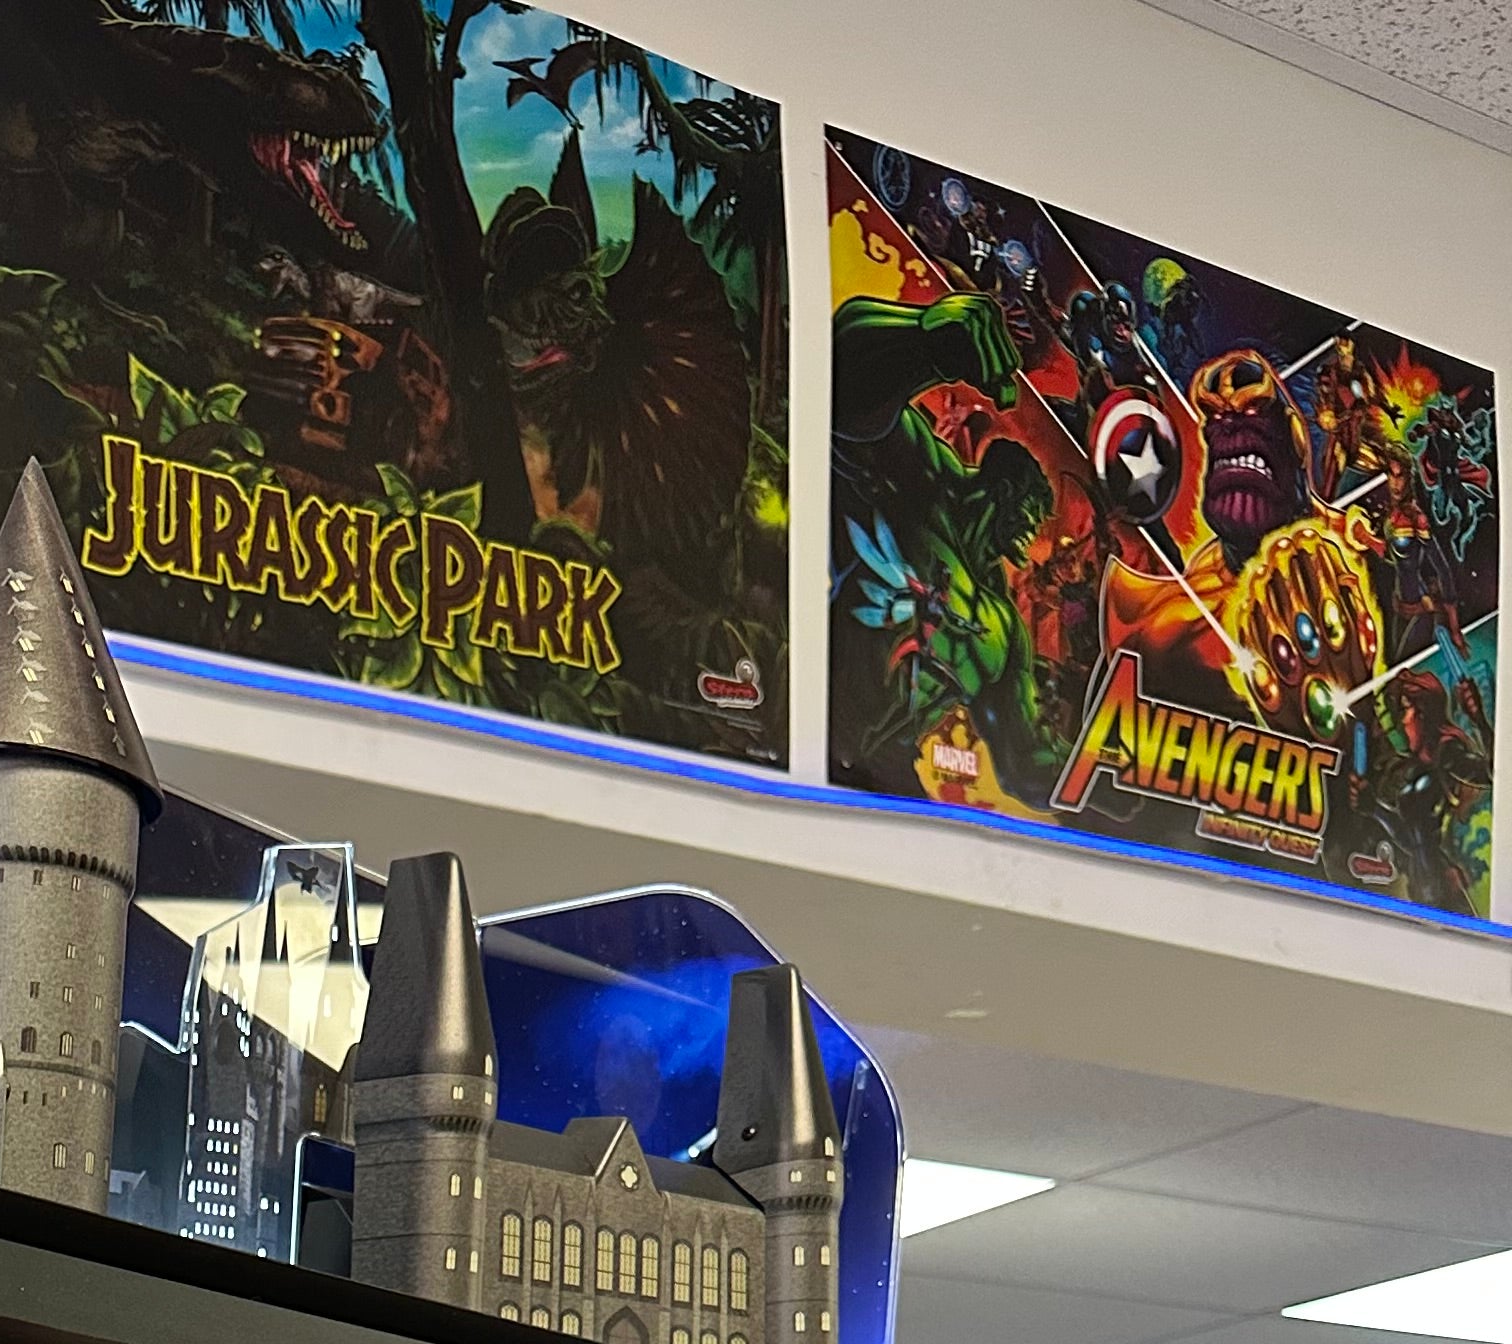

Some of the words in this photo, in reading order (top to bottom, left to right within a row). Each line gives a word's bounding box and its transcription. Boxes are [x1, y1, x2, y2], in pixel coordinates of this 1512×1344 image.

[83, 434, 418, 627] JURASSIC
[420, 513, 622, 673] PARK
[933, 744, 978, 777] MARVEL
[1059, 655, 1338, 831] AVENGERS
